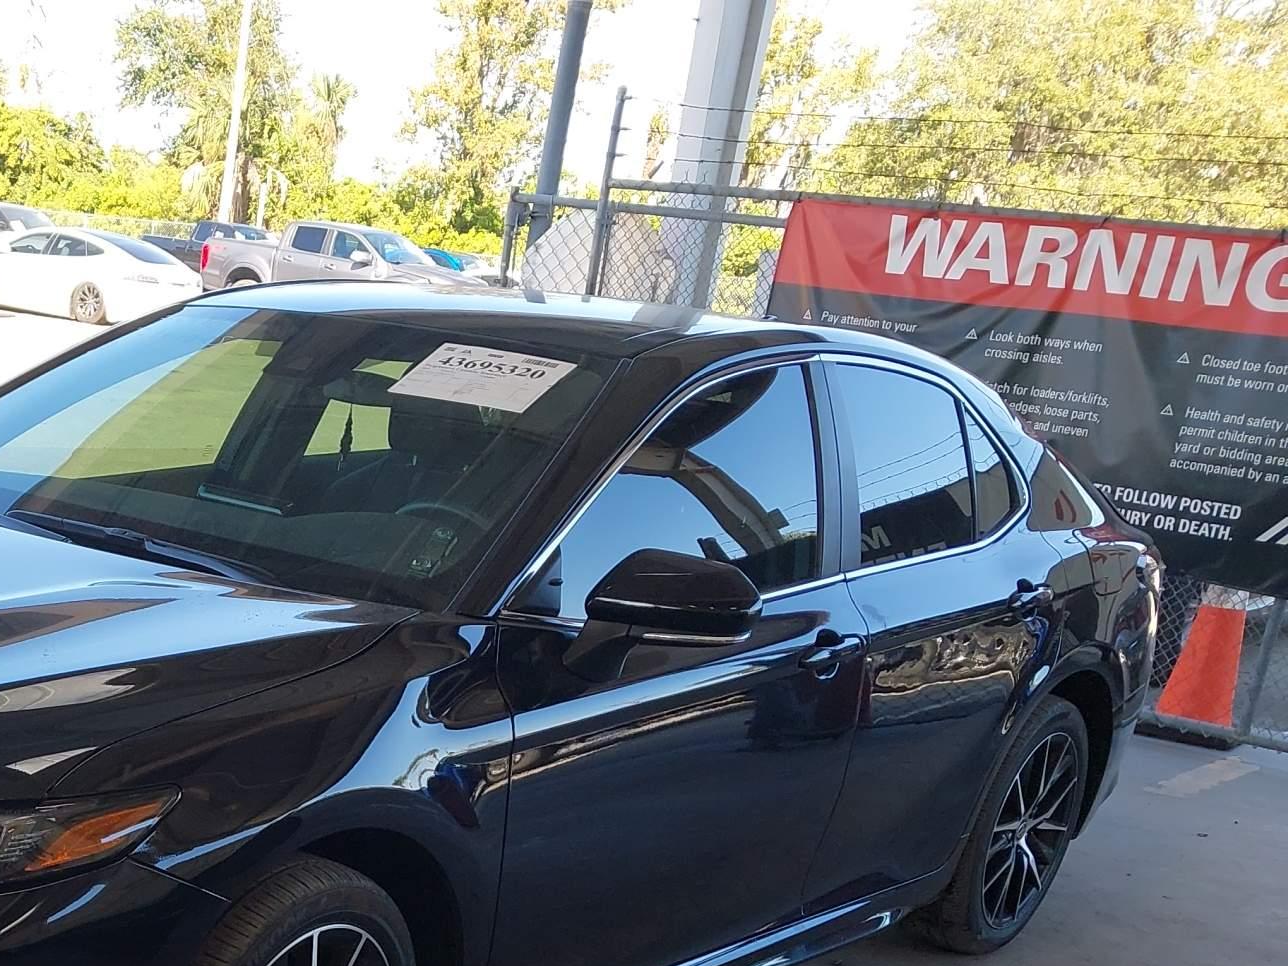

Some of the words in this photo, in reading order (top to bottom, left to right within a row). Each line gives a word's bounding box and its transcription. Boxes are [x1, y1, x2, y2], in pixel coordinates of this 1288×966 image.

[885, 214, 1288, 313] WARNING
[821, 310, 840, 325] Pay
[840, 315, 880, 329] attention
[881, 319, 892, 330] to
[894, 322, 918, 333] your
[989, 329, 1014, 343] Look
[1016, 330, 1042, 346] both
[1044, 338, 1071, 350] ways
[1073, 339, 1103, 352] when
[438, 355, 546, 380] 43695320
[984, 347, 1030, 363] crossing
[1032, 351, 1064, 365] aisles.
[1201, 354, 1242, 370] Closed
[1242, 360, 1261, 372] toe
[1195, 373, 1225, 386] must
[1227, 375, 1241, 388] be
[1244, 379, 1274, 391] worn
[985, 381, 1010, 394] tch
[1013, 383, 1028, 396] for
[1030, 385, 1110, 408] loaders/forklifts,
[1009, 400, 1042, 416] edges,
[1043, 404, 1069, 418] loose
[1071, 410, 1101, 424] parts,
[1185, 406, 1221, 422] Health
[1223, 413, 1246, 425] and
[1246, 415, 1284, 433] safety
[1034, 421, 1050, 432] and
[1051, 425, 1088, 438] uneven
[1179, 425, 1215, 439] permit
[1217, 429, 1263, 446] children
[1264, 434, 1276, 447] in
[1174, 442, 1201, 454] yard
[1203, 446, 1217, 456] or
[1218, 446, 1263, 465] bidding
[1170, 458, 1246, 477] accompanied
[1247, 468, 1263, 482] by
[1264, 473, 1280, 484] an
[1114, 486, 1177, 510] FOLLOW
[1179, 497, 1242, 520] POSTED
[1117, 507, 1152, 527] URY
[1154, 514, 1175, 531] OR
[1178, 519, 1233, 542] DEATH.
